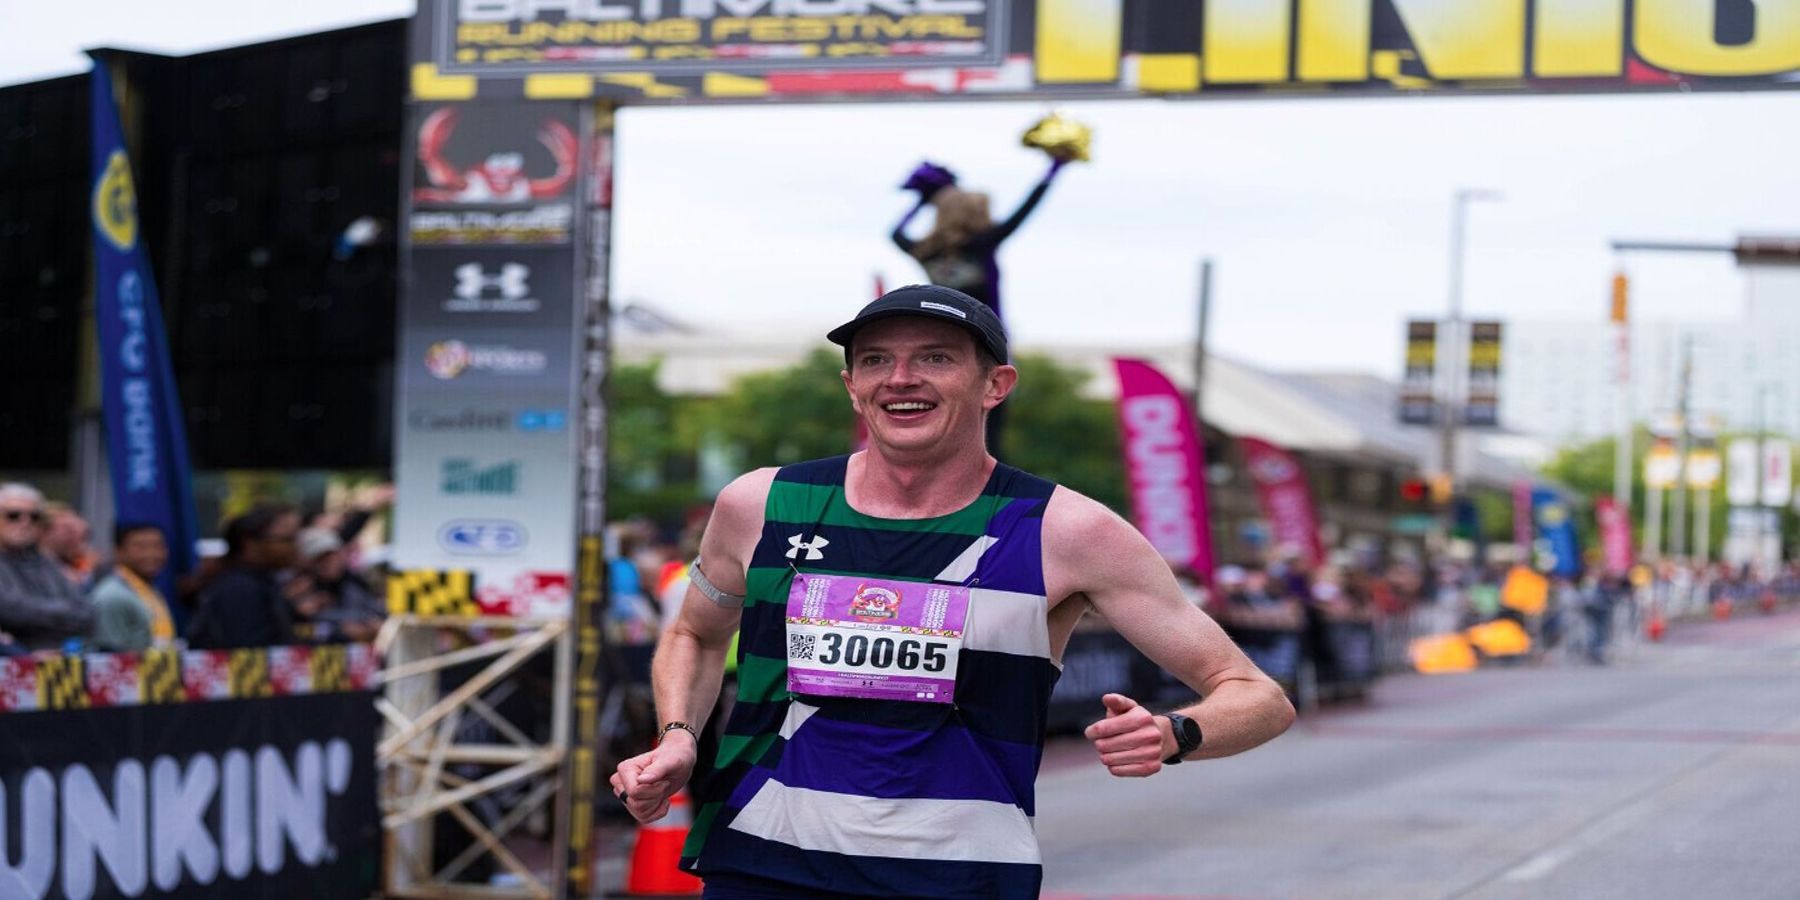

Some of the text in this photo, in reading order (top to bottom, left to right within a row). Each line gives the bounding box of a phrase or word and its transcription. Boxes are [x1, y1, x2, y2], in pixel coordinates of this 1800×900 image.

[457, 15, 986, 45] RUNNING FESTIVAL
[819, 632, 948, 672] 30065
